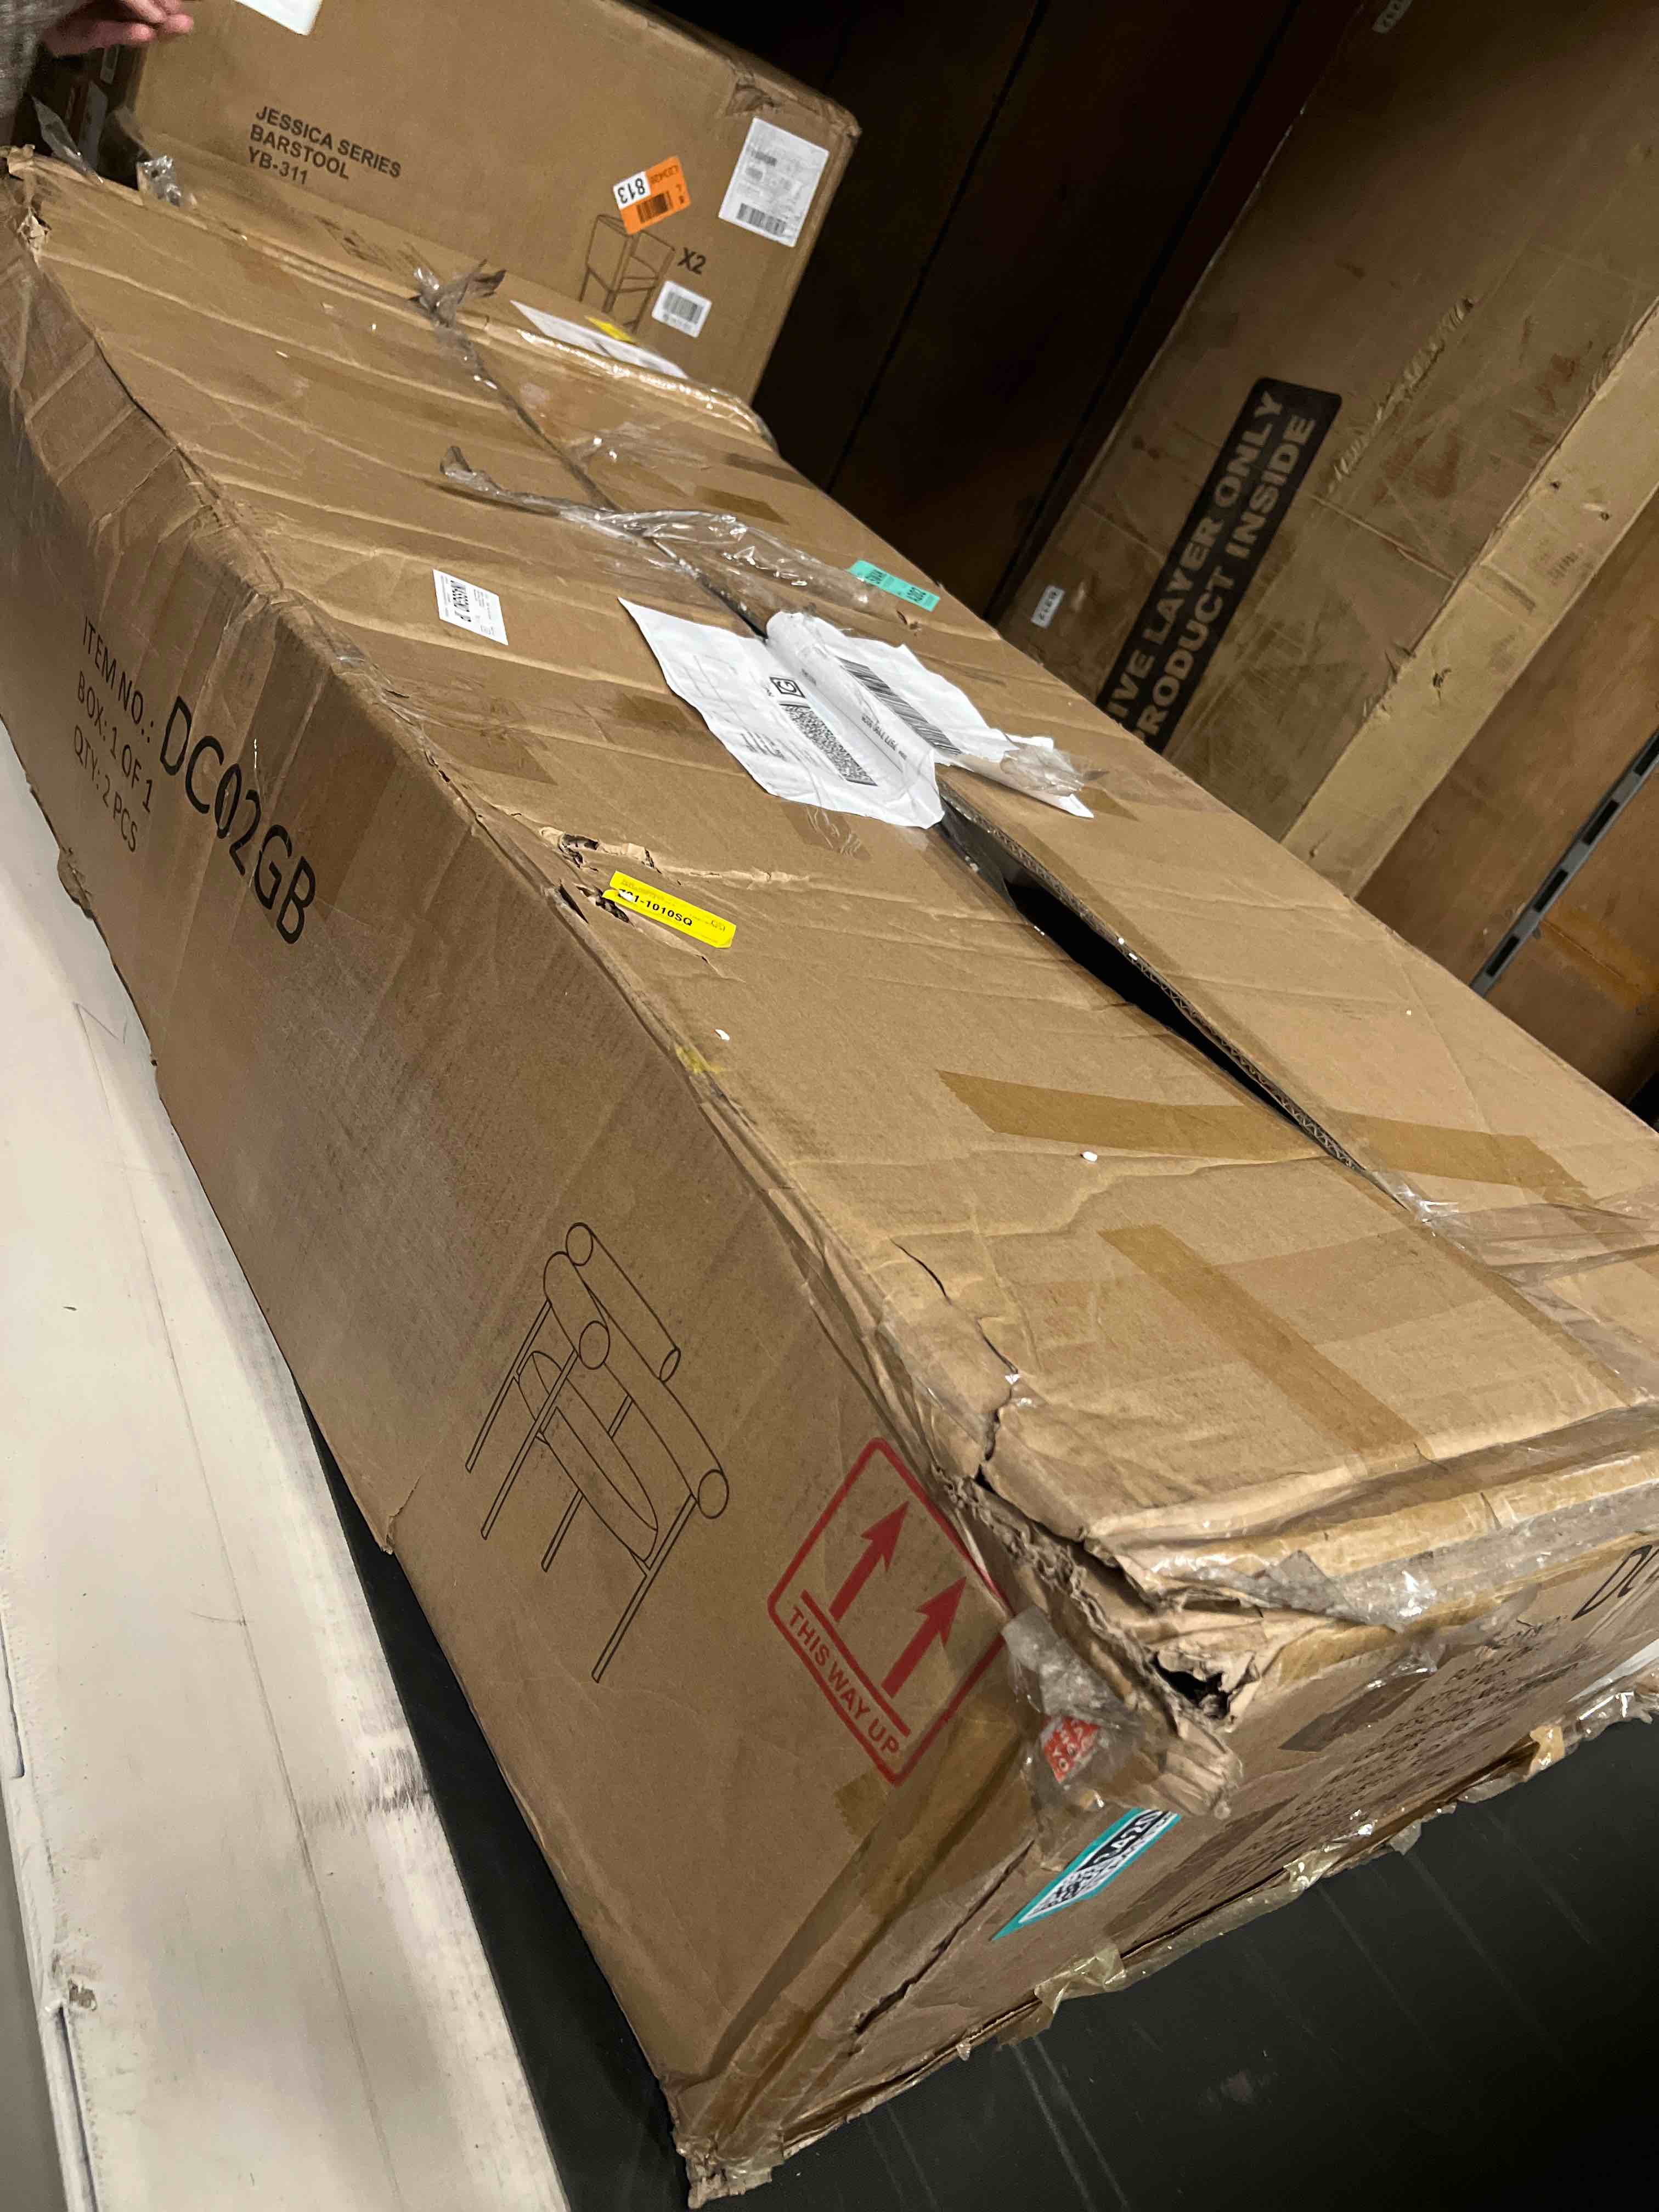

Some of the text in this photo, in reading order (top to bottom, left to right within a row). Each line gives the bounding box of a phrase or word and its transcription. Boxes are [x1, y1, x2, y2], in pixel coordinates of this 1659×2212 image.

[249, 146, 307, 184] YB-311
[250, 124, 349, 179] BARSTOOL
[256, 106, 402, 178] JESSICA SERIES
[617, 178, 646, 204] 813
[677, 247, 707, 275] X2
[1226, 415, 1316, 560] INSIDE
[1107, 390, 1284, 719] IVE LAYER ONLY
[75, 725, 138, 853] QTY: 2 PCS
[78, 671, 153, 814] BOX: 1 OF 1
[83, 616, 116, 690] ITEM
[160, 696, 317, 944] DC02GB
[790, 1606, 900, 1754] THIS WAY UP
